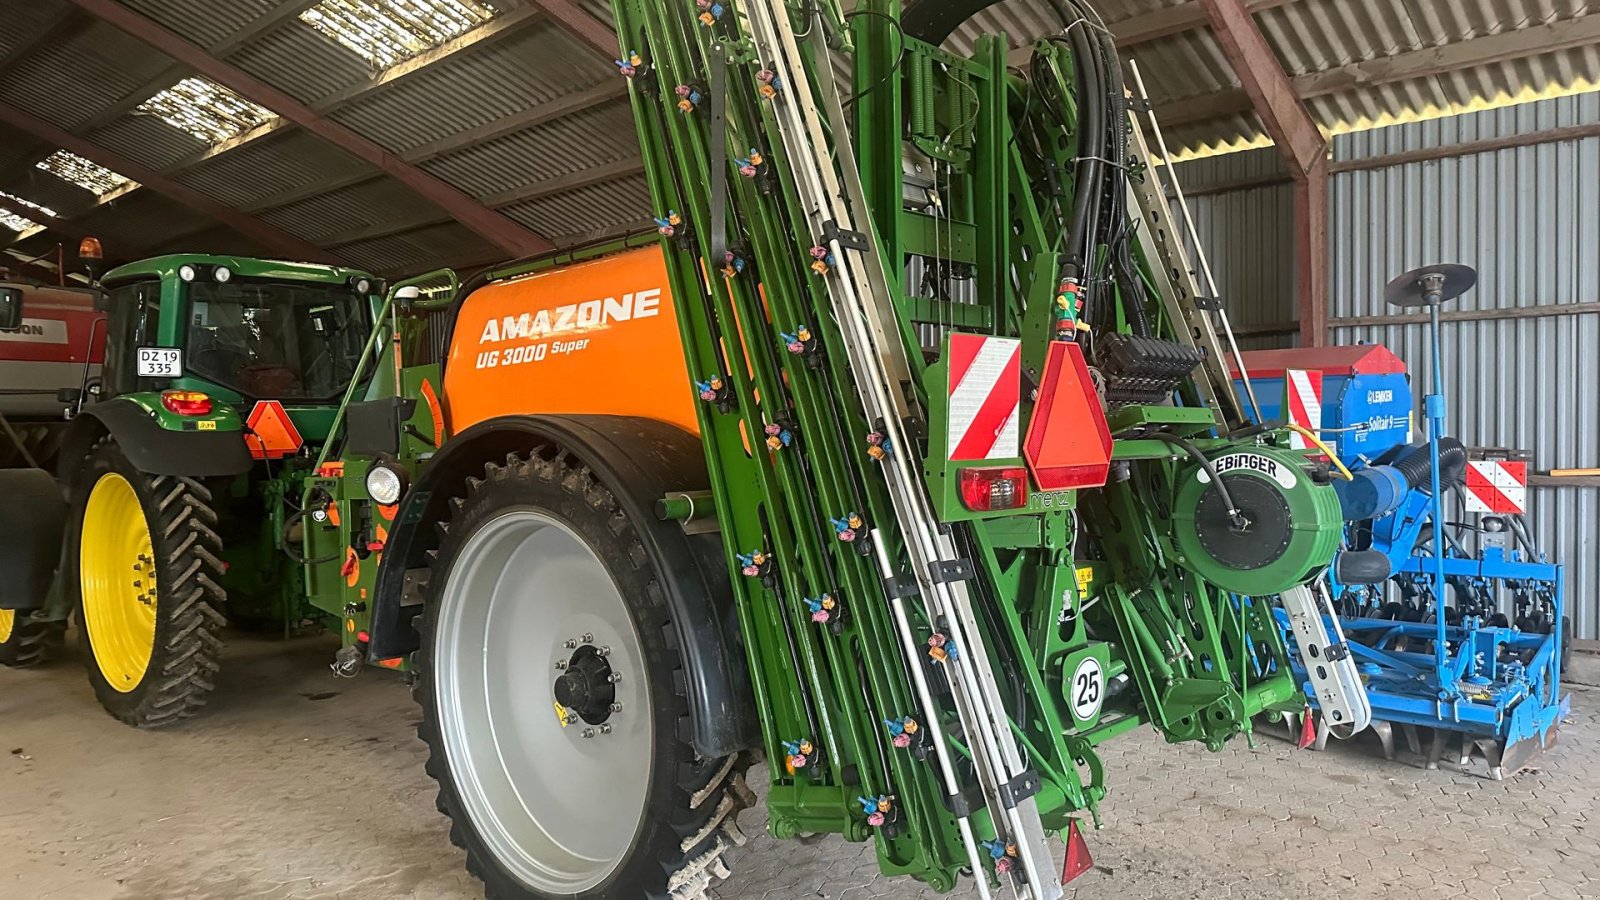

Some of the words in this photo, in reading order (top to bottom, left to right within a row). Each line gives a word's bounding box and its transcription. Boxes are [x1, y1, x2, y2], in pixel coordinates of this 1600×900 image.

[479, 288, 661, 344] AMAZONE
[141, 351, 159, 361] DZ
[164, 352, 177, 362] 19
[476, 351, 499, 369] UG
[502, 343, 547, 366] 3000
[551, 338, 590, 355] Super
[148, 363, 172, 374] 335
[1372, 389, 1393, 404] LEMKEN
[1389, 414, 1394, 430] 9
[1077, 670, 1098, 707] 25
